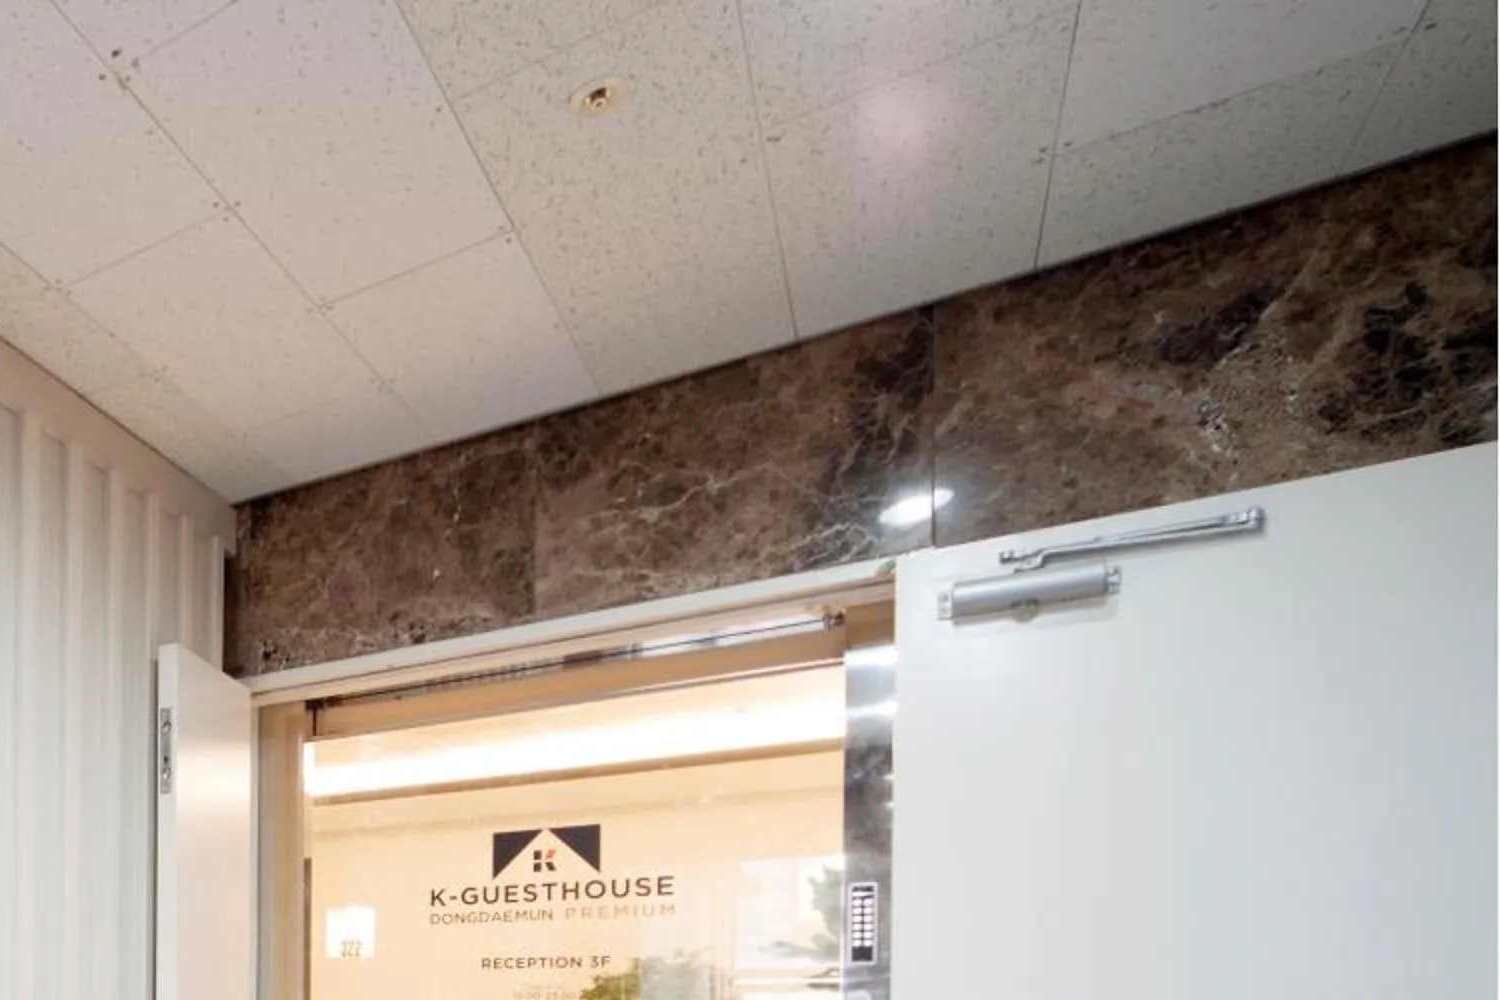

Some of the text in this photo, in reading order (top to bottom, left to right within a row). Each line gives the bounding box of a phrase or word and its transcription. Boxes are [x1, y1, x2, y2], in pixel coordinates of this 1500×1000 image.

[430, 876, 675, 907] K-GUESTHOUSE
[429, 903, 677, 925] DONGDAEMUN PREMIUM
[480, 955, 611, 970] RECEPTION 3F
